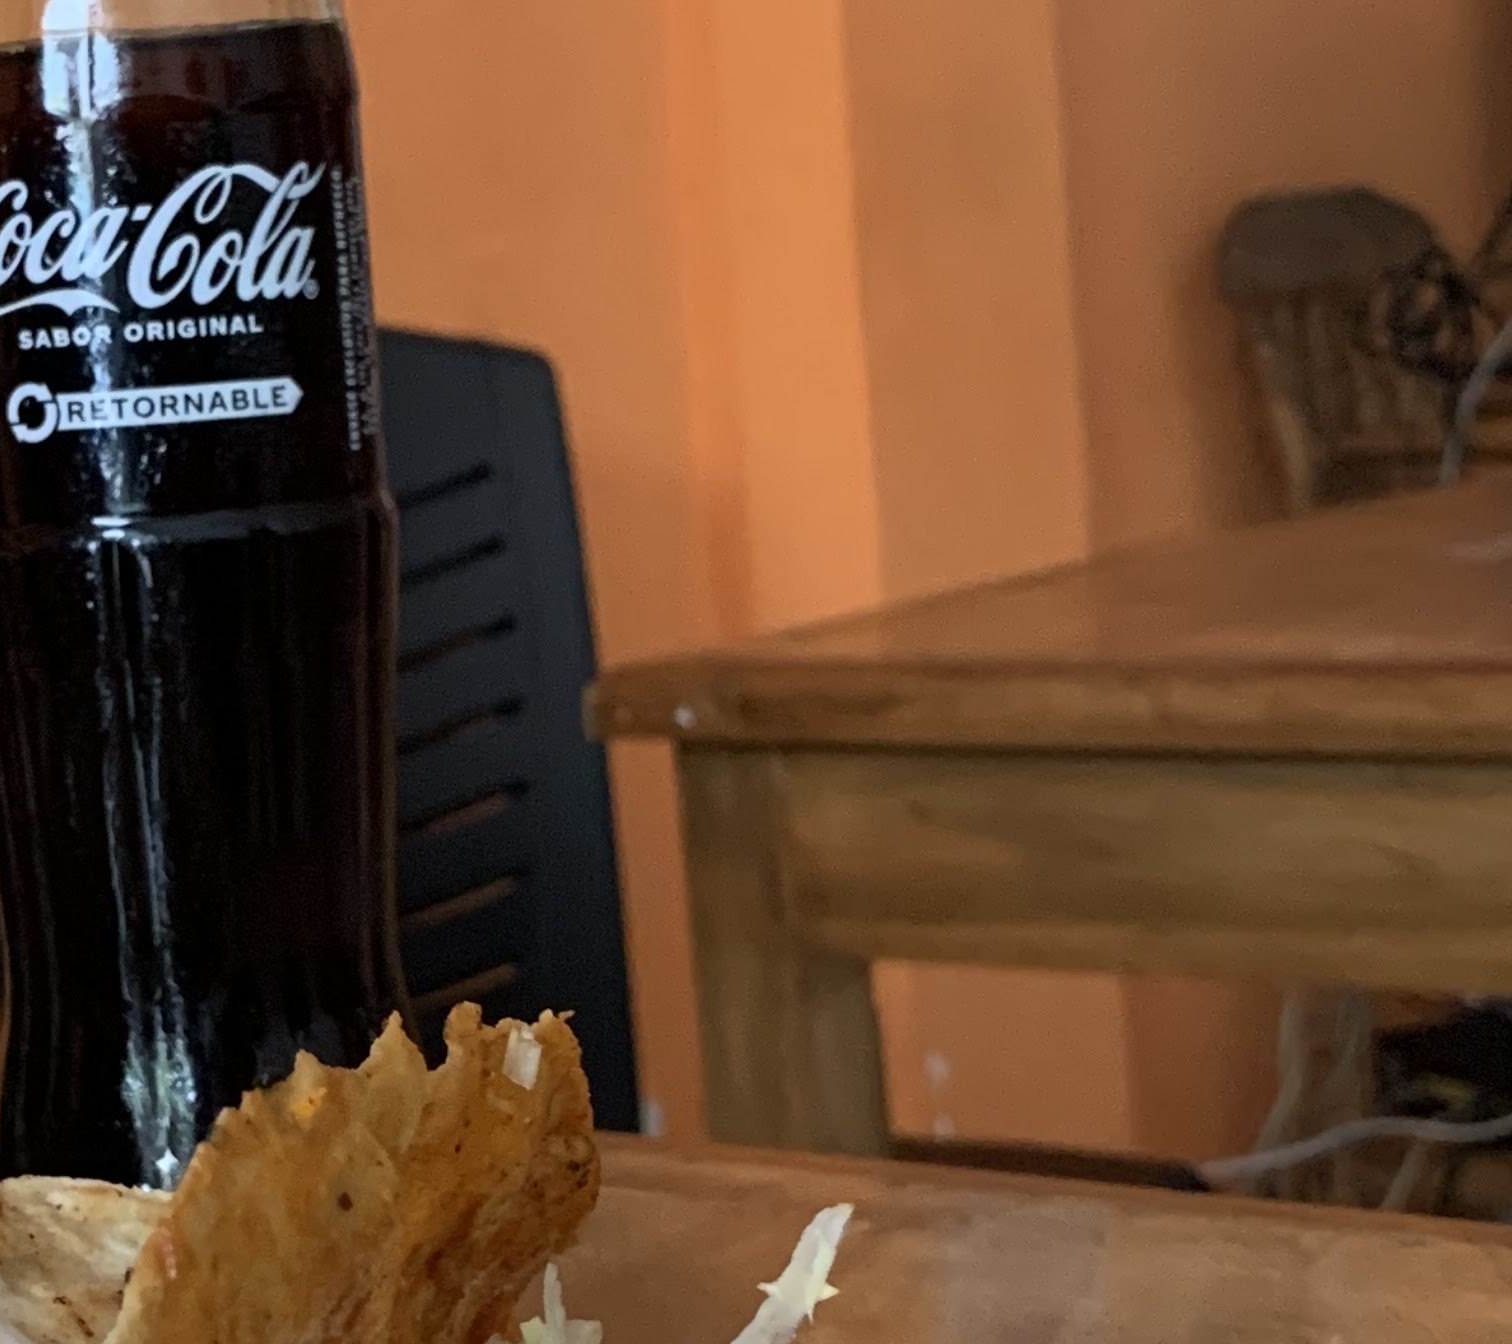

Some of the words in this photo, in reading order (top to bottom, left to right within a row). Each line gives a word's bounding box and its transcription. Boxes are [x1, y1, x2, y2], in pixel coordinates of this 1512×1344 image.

[18, 324, 113, 350] SABOR
[124, 313, 263, 343] ORIGINAL
[67, 384, 288, 424] RETORNABLE
